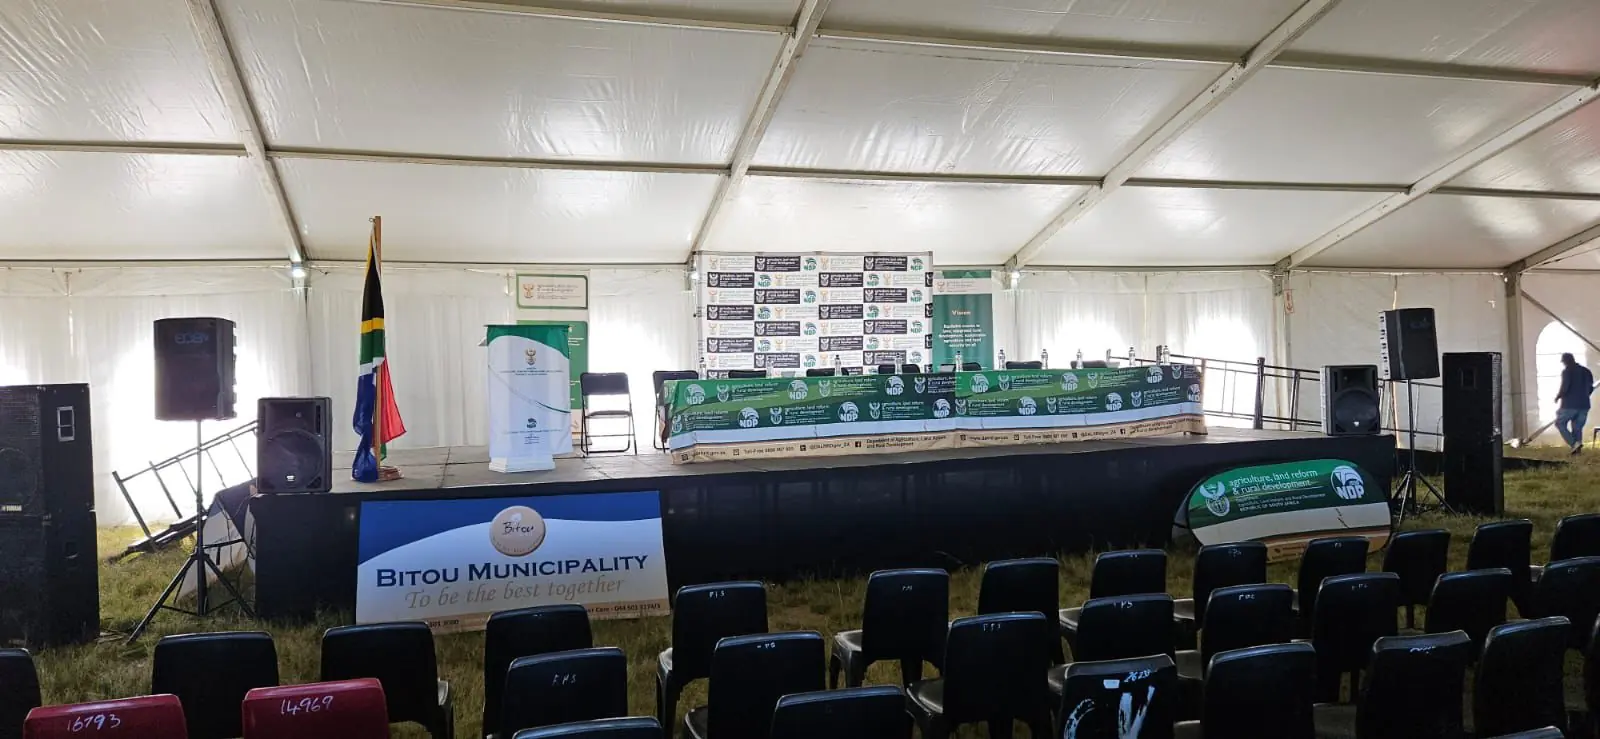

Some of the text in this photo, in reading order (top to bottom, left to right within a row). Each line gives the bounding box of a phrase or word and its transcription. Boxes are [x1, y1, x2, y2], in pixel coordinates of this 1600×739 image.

[886, 387, 903, 396] NDP
[971, 384, 988, 393] NDP
[1061, 383, 1077, 391] NDP
[686, 395, 704, 405] NDP
[790, 391, 807, 400] NDP
[1018, 407, 1036, 415] NDP
[1106, 403, 1122, 411] NDP
[933, 409, 950, 417] NDP
[840, 414, 858, 422] NDP
[739, 419, 759, 427] NDP
[1229, 469, 1318, 487] agriculture, land reform
[1241, 485, 1260, 494] rural
[1262, 480, 1311, 491] development
[1336, 485, 1364, 499] NDP
[502, 521, 534, 535] Bitou
[376, 555, 648, 587] BITOU MUNICIPALITY
[405, 574, 625, 609] To be the best together
[281, 695, 334, 715] 14969
[67, 713, 120, 732] 16793
